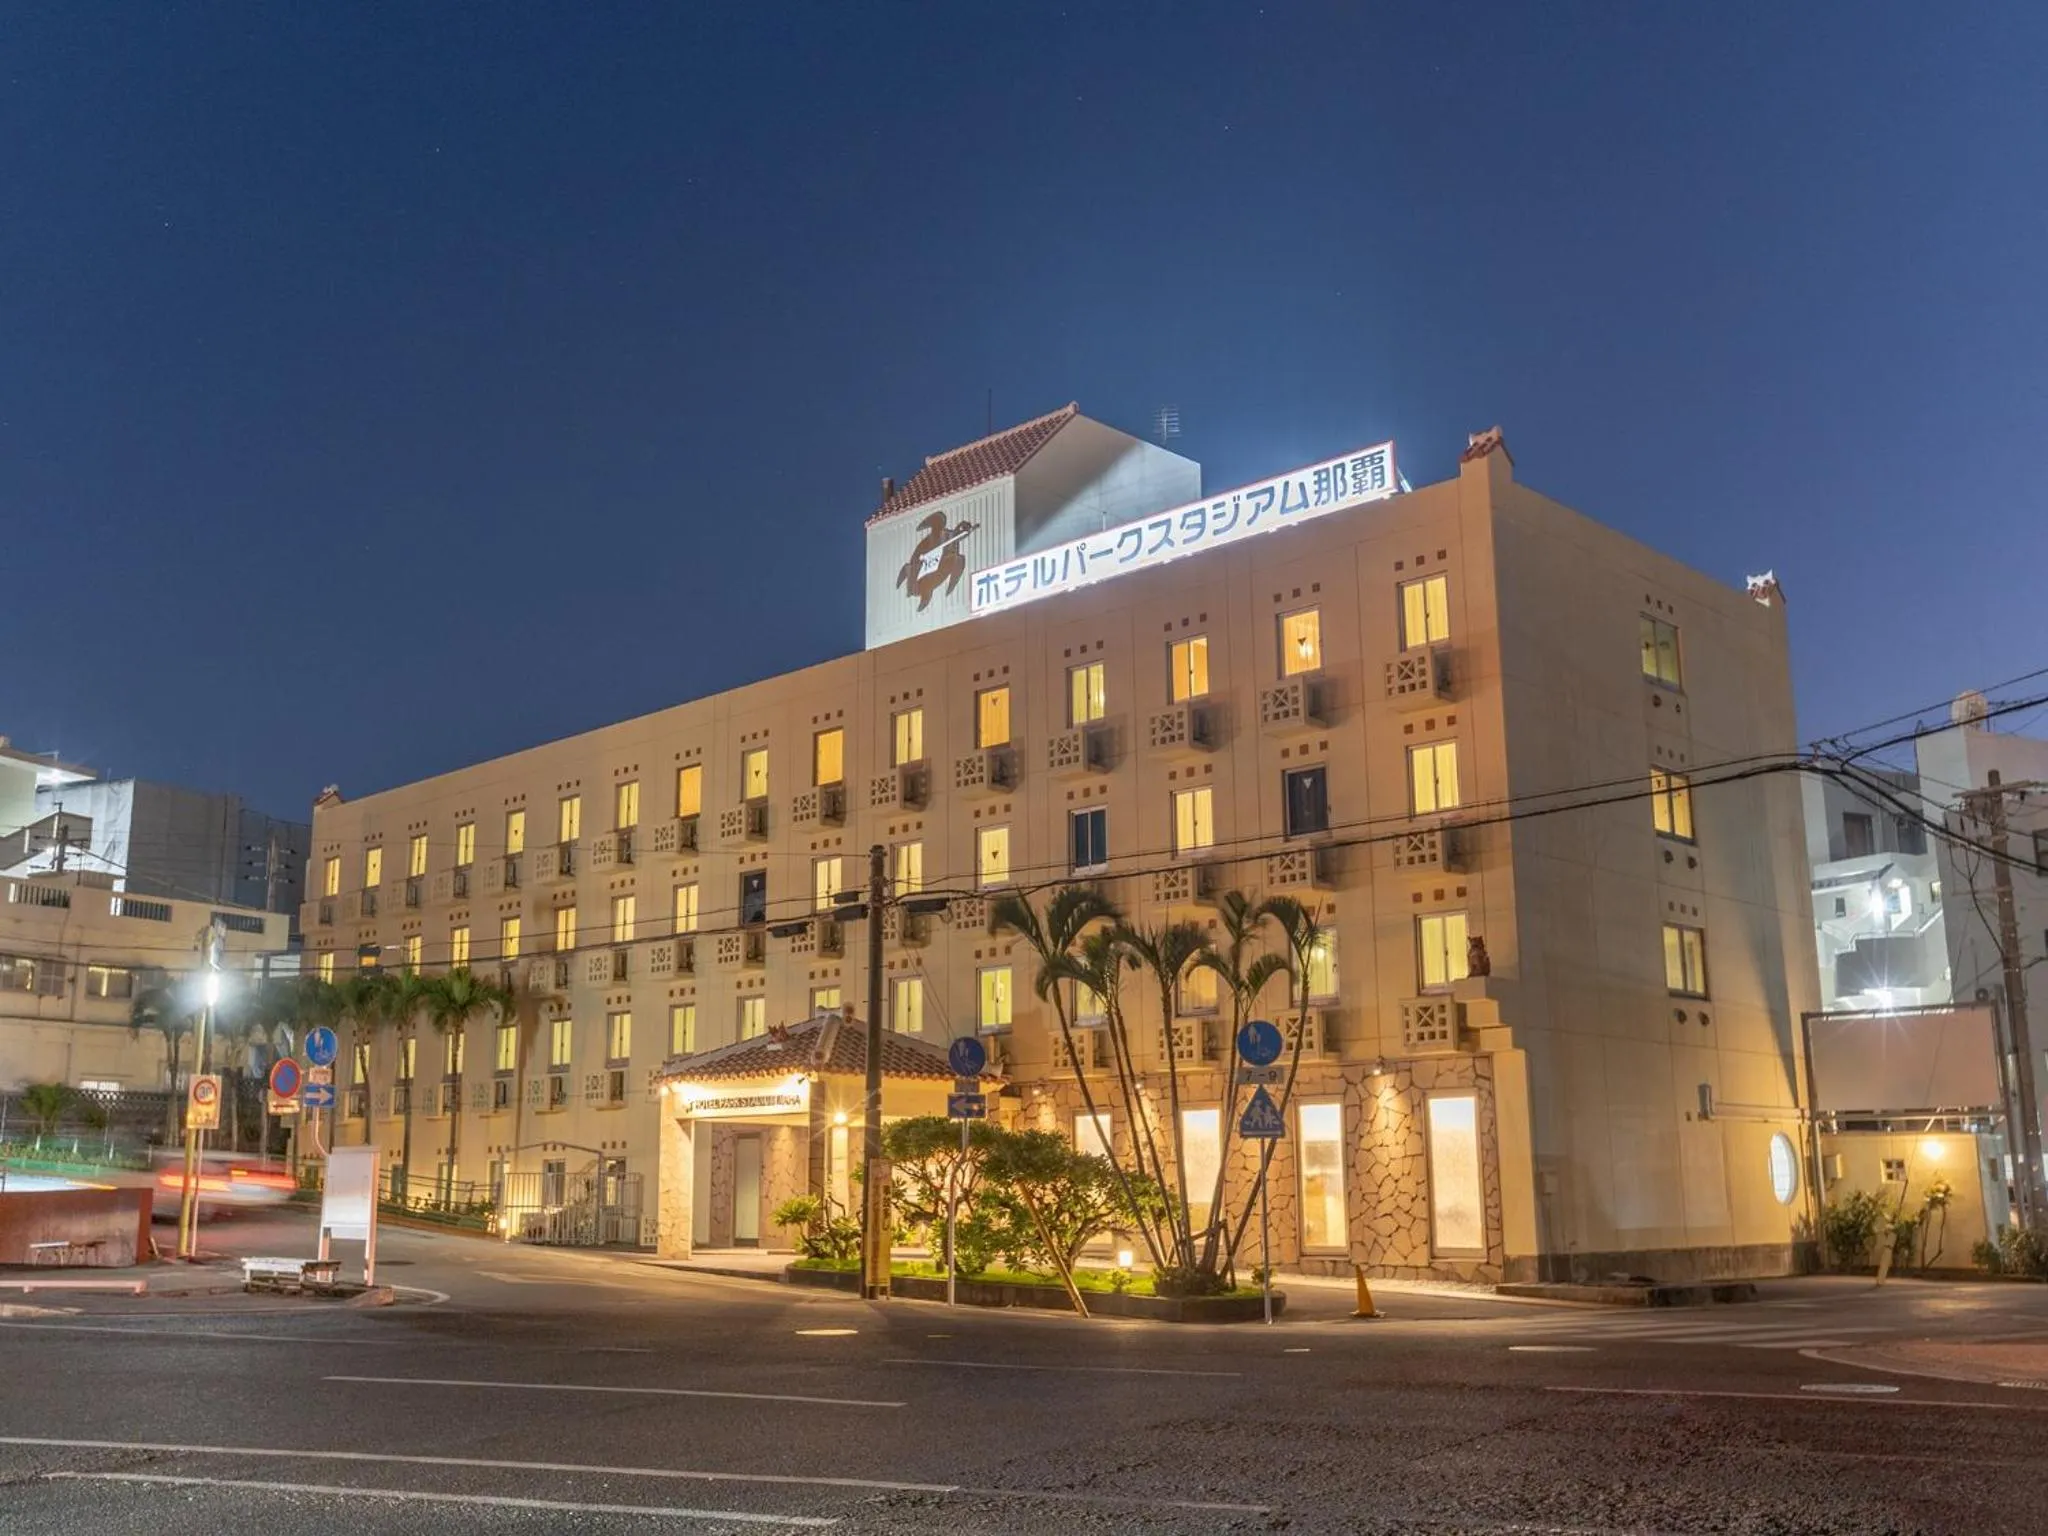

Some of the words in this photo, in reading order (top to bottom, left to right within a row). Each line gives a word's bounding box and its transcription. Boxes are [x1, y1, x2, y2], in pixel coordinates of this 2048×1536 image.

[976, 449, 1386, 606] ホテルパークスタジアム那覇
